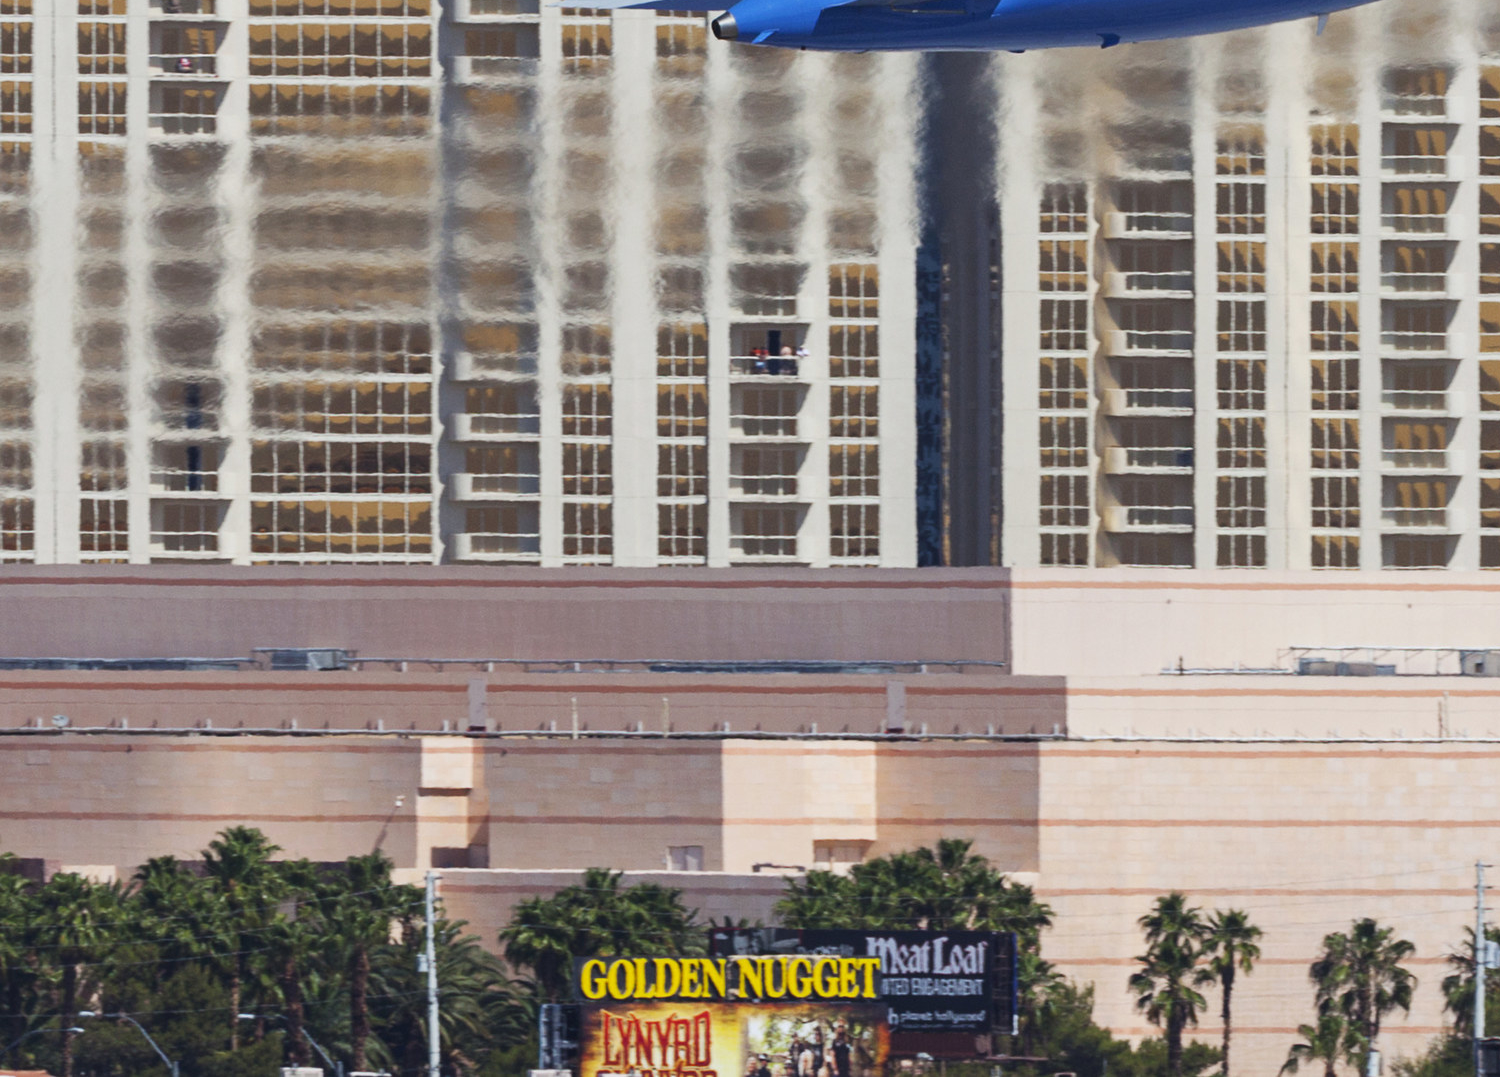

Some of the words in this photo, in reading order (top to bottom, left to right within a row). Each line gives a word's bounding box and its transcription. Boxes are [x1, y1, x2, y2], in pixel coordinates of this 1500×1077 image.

[866, 936, 931, 975] Meat
[932, 936, 987, 975] Loaf
[581, 958, 727, 1000] GOLDEN
[736, 956, 881, 999] NUGGET
[911, 977, 984, 996] ENGAGEMENT
[601, 1009, 712, 1067] LYNYRD
